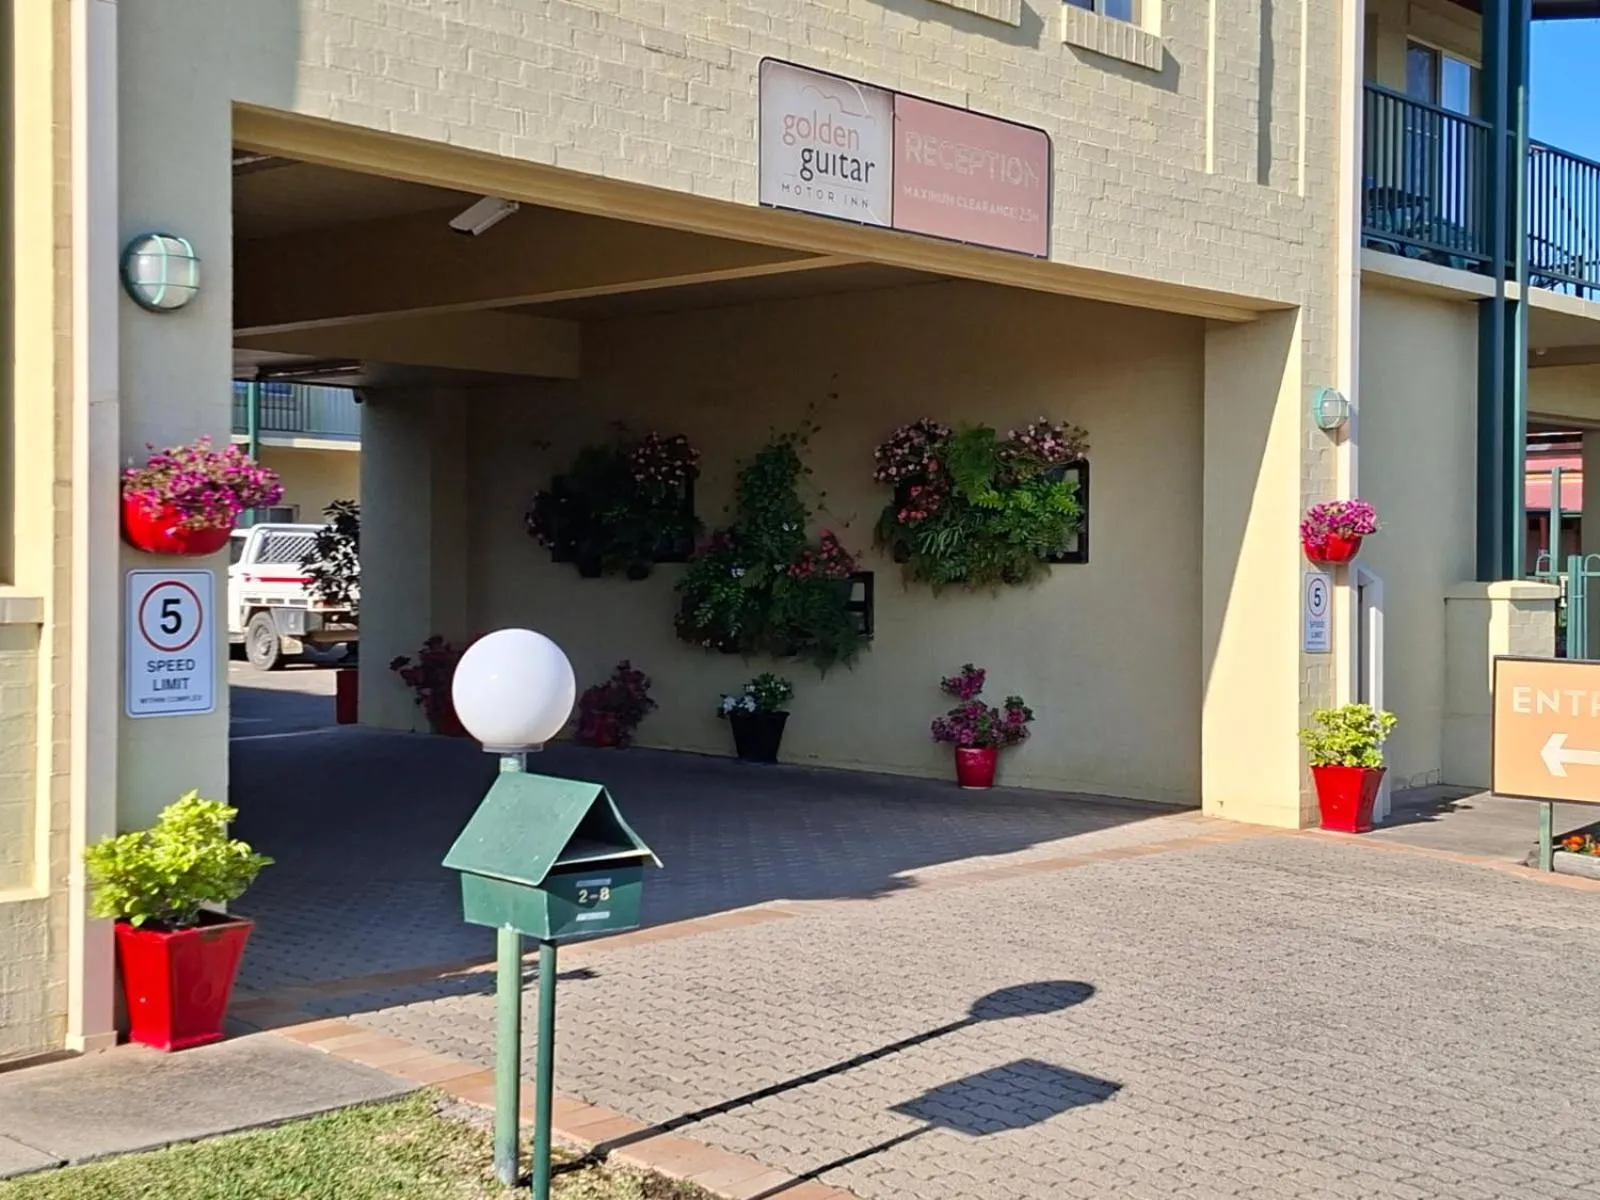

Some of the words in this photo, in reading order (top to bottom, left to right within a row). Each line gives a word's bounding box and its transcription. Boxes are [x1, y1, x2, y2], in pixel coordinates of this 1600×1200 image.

[782, 109, 860, 151] golden
[800, 147, 876, 183] guitar
[905, 130, 1040, 188] RECEPTION
[781, 183, 835, 204] MOTOR
[843, 193, 868, 208] INN
[903, 185, 954, 209] MAXIMUM
[1314, 587, 1322, 607] 5
[160, 598, 182, 635] 5
[146, 658, 196, 673] SPEED
[152, 677, 190, 692] LIMIT
[578, 886, 610, 904] 2-8
